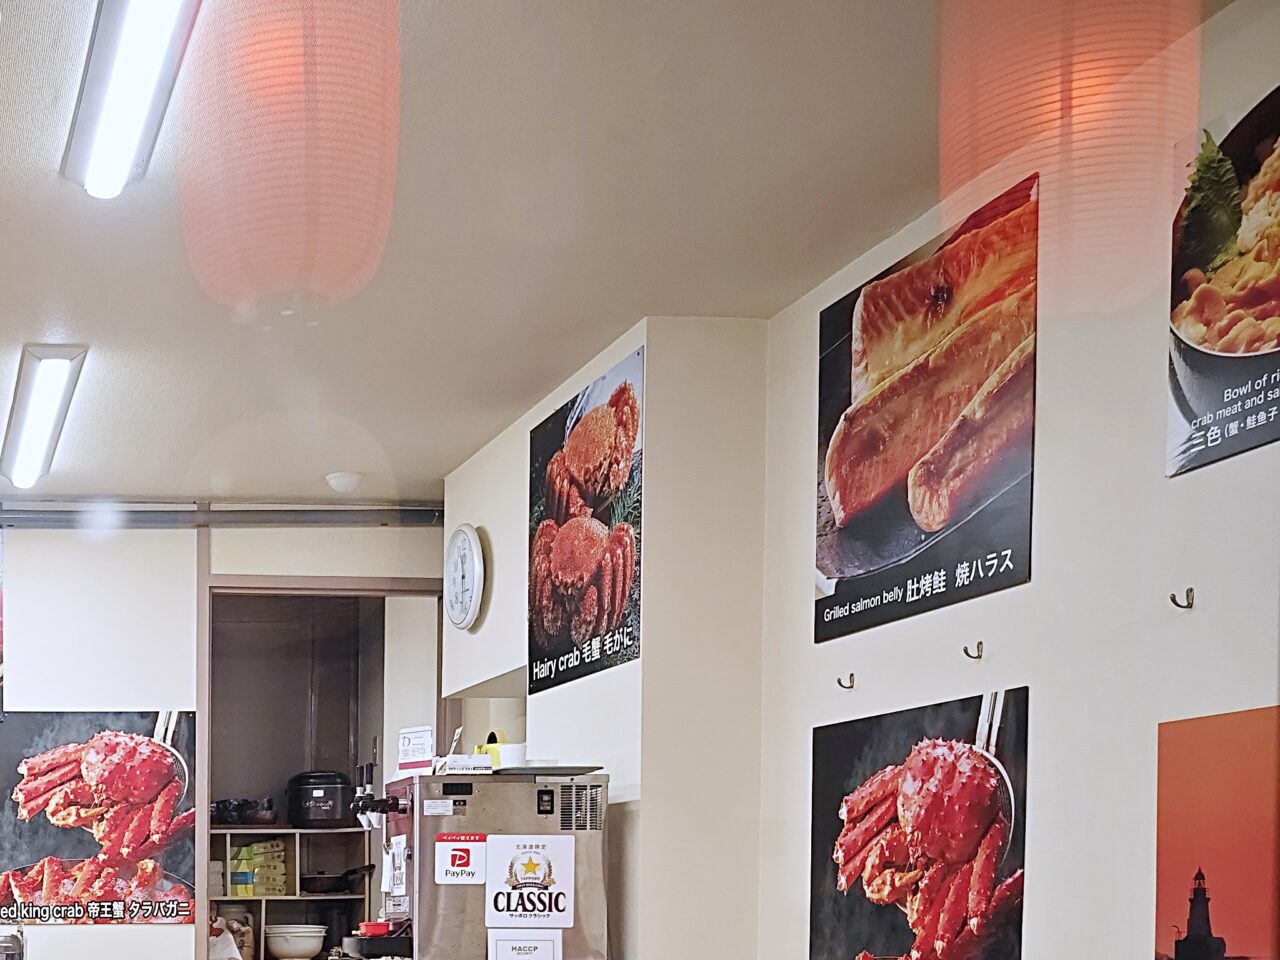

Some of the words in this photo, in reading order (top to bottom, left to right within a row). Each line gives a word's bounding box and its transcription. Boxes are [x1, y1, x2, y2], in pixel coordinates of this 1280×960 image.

[1223, 380, 1252, 402] Bowl
[1254, 373, 1268, 390] of
[1191, 411, 1214, 430] crab
[1216, 400, 1242, 420] meat
[1244, 390, 1264, 410] and
[1190, 425, 1222, 452] 三色
[823, 602, 850, 622] Grilled
[851, 594, 881, 613] salmon
[882, 586, 904, 603] belly
[955, 549, 1015, 588] 焼ハラス
[533, 657, 557, 680] Hairy
[558, 646, 580, 672] crab
[582, 636, 601, 663] 毛蟹
[603, 626, 633, 655] 毛がに
[445, 869, 476, 878] PayPay
[21, 904, 50, 921] king
[52, 904, 84, 919] crab
[87, 901, 125, 919] 帝王蟹
[129, 901, 191, 918] タラバガニ
[493, 891, 566, 913] CLASSIC
